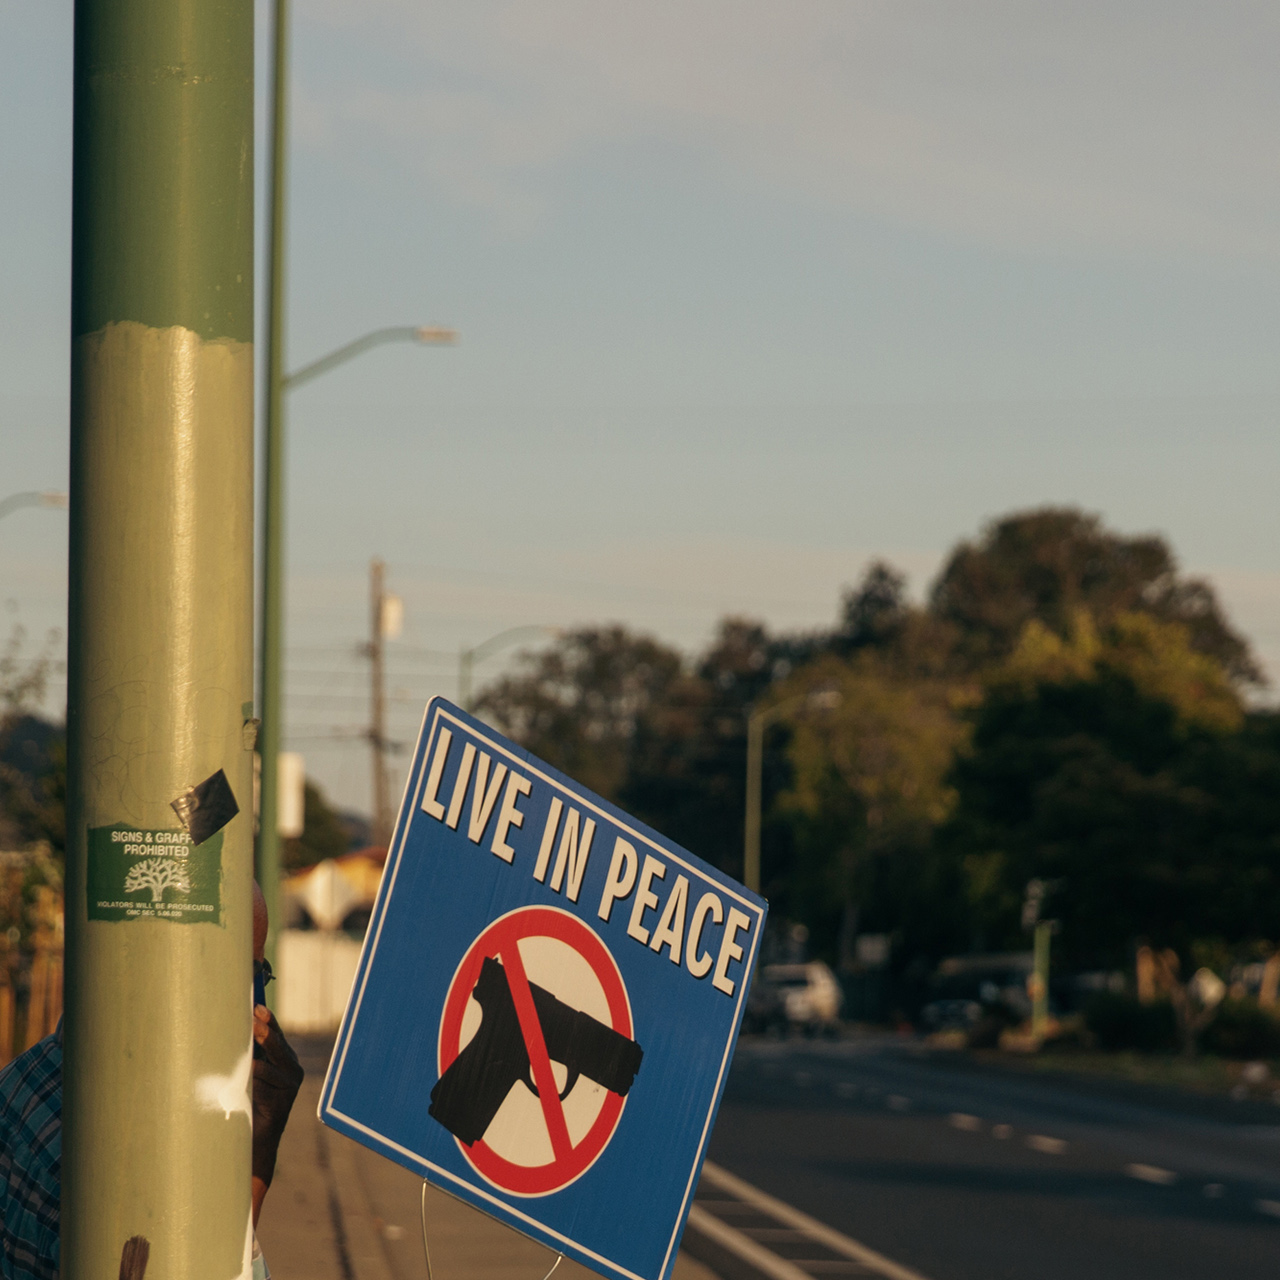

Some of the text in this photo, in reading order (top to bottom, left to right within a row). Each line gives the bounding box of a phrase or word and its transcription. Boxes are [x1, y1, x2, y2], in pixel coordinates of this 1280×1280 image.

[111, 831, 195, 844] SIGNS & GRAFF
[124, 844, 190, 857] PROHIBITED
[420, 726, 752, 998] LIVE IN PEACE
[97, 901, 134, 909] VIOLATORS
[167, 903, 215, 912] PROSECUTED
